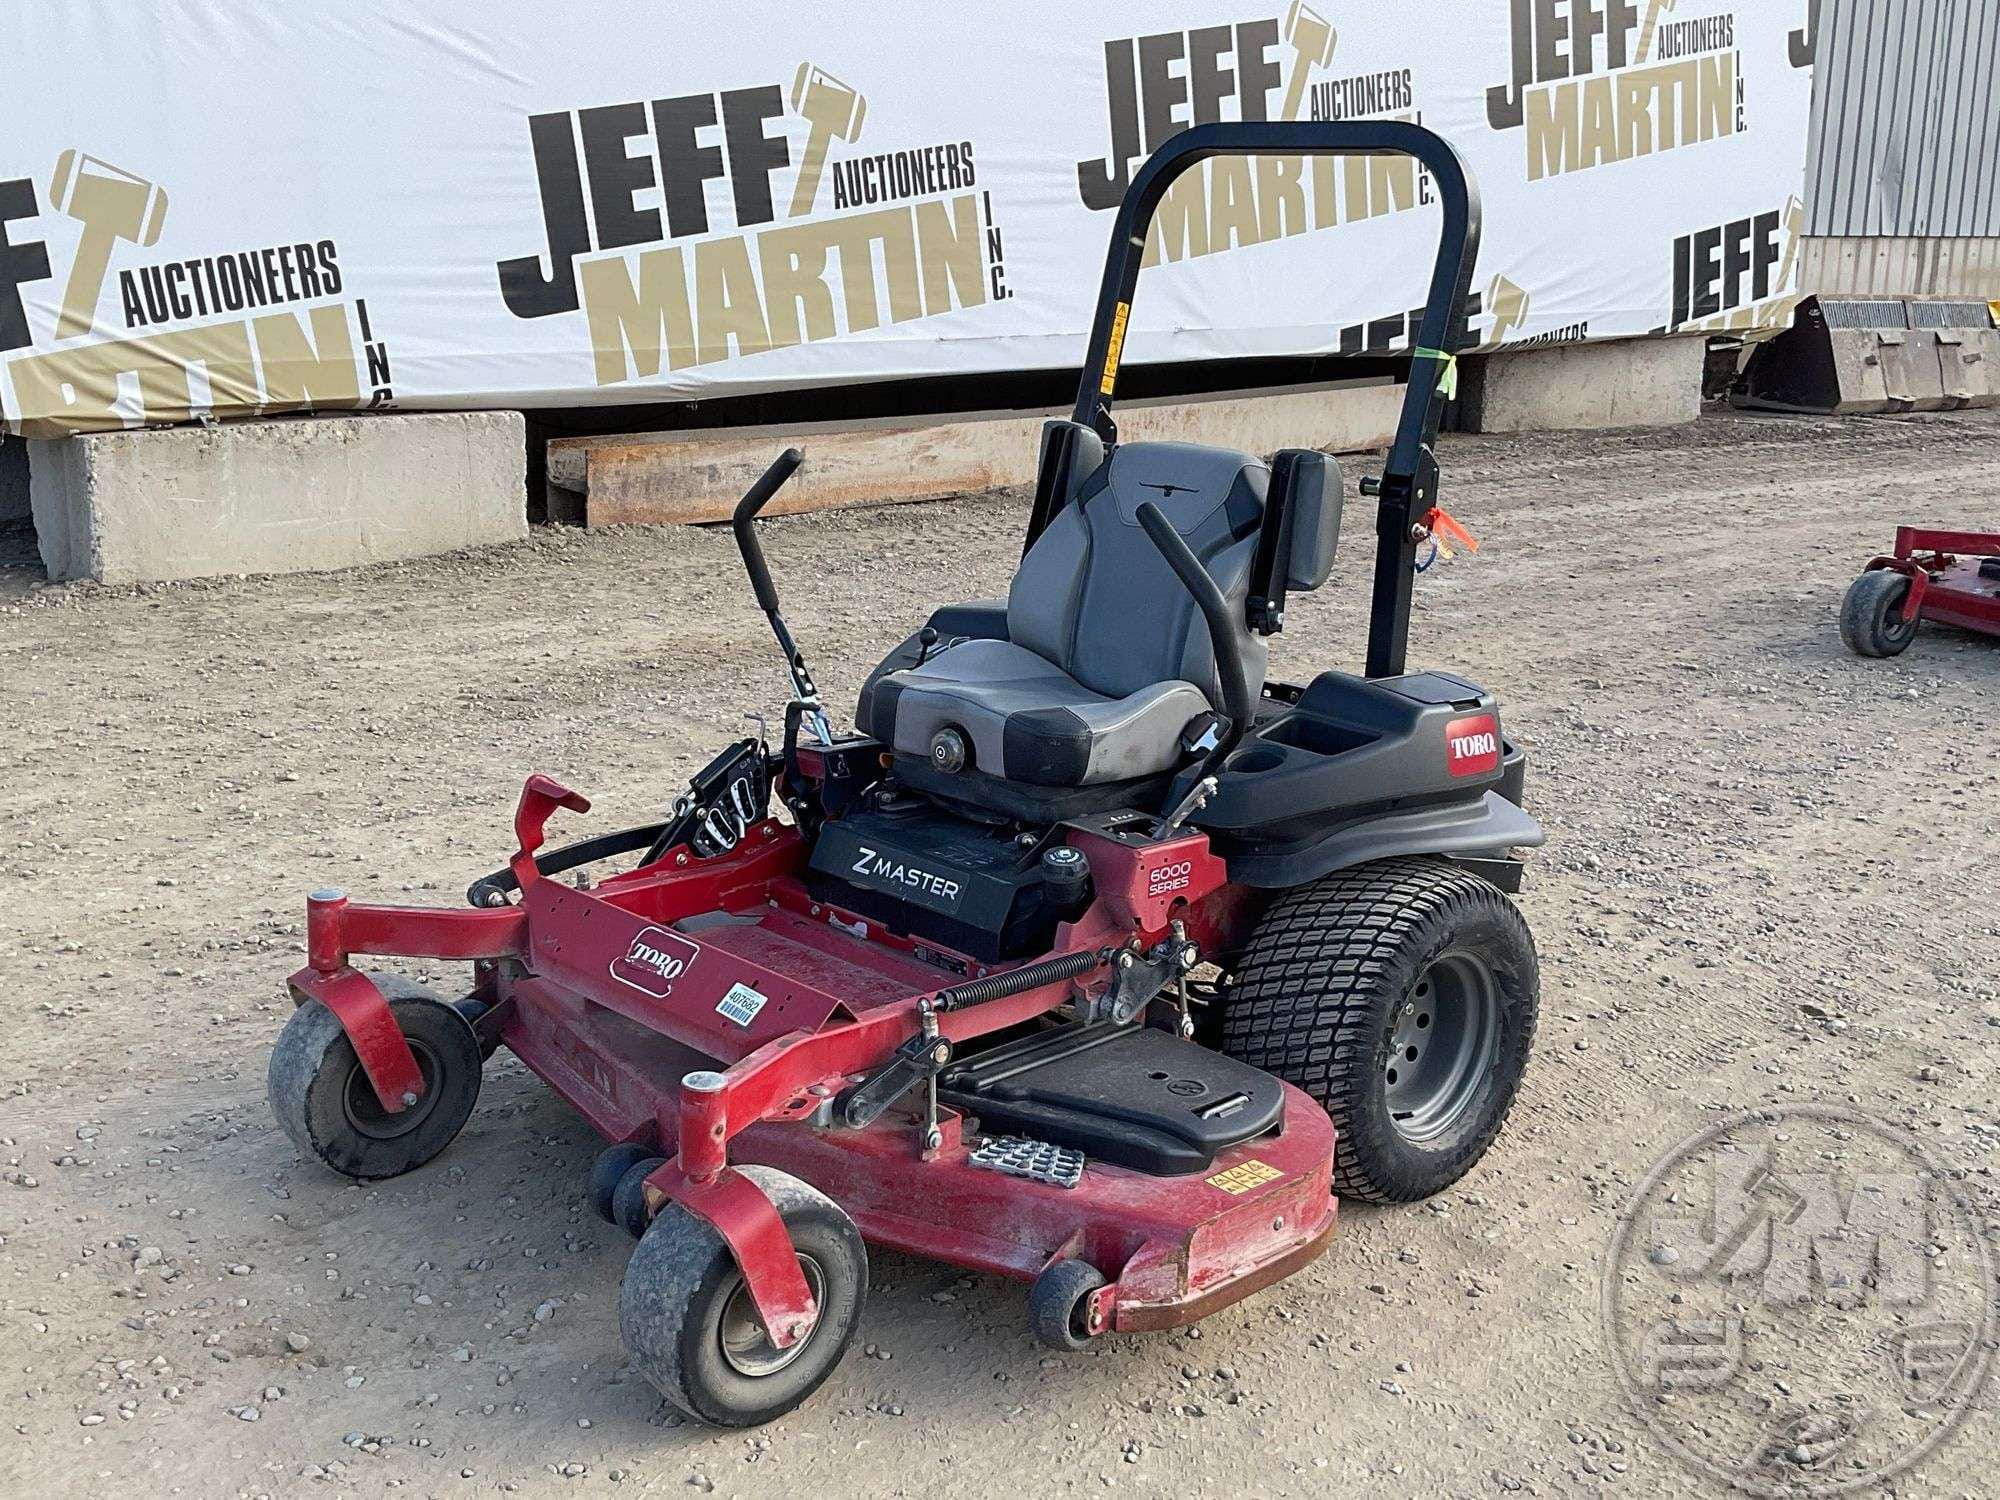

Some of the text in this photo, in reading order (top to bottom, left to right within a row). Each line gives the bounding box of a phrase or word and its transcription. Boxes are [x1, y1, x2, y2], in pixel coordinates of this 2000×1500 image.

[1486, 0, 1637, 130] JEFF
[1658, 14, 1734, 60] AUCTIONEERS
[1077, 18, 1281, 211] JEFF
[1310, 68, 1412, 121] AUCTIONEERS
[1526, 53, 1733, 182] MARTIN
[497, 84, 790, 319] JEFF
[832, 141, 976, 210] AUCTIONEERS
[118, 239, 343, 329] AUCTIONEERS
[579, 194, 987, 387] MARTIN
[1451, 732, 1497, 760] TORO
[1148, 876, 1190, 896] SERIES
[1150, 861, 1192, 882] 6000
[629, 942, 684, 979] TORO
[729, 990, 760, 1013] 407682
